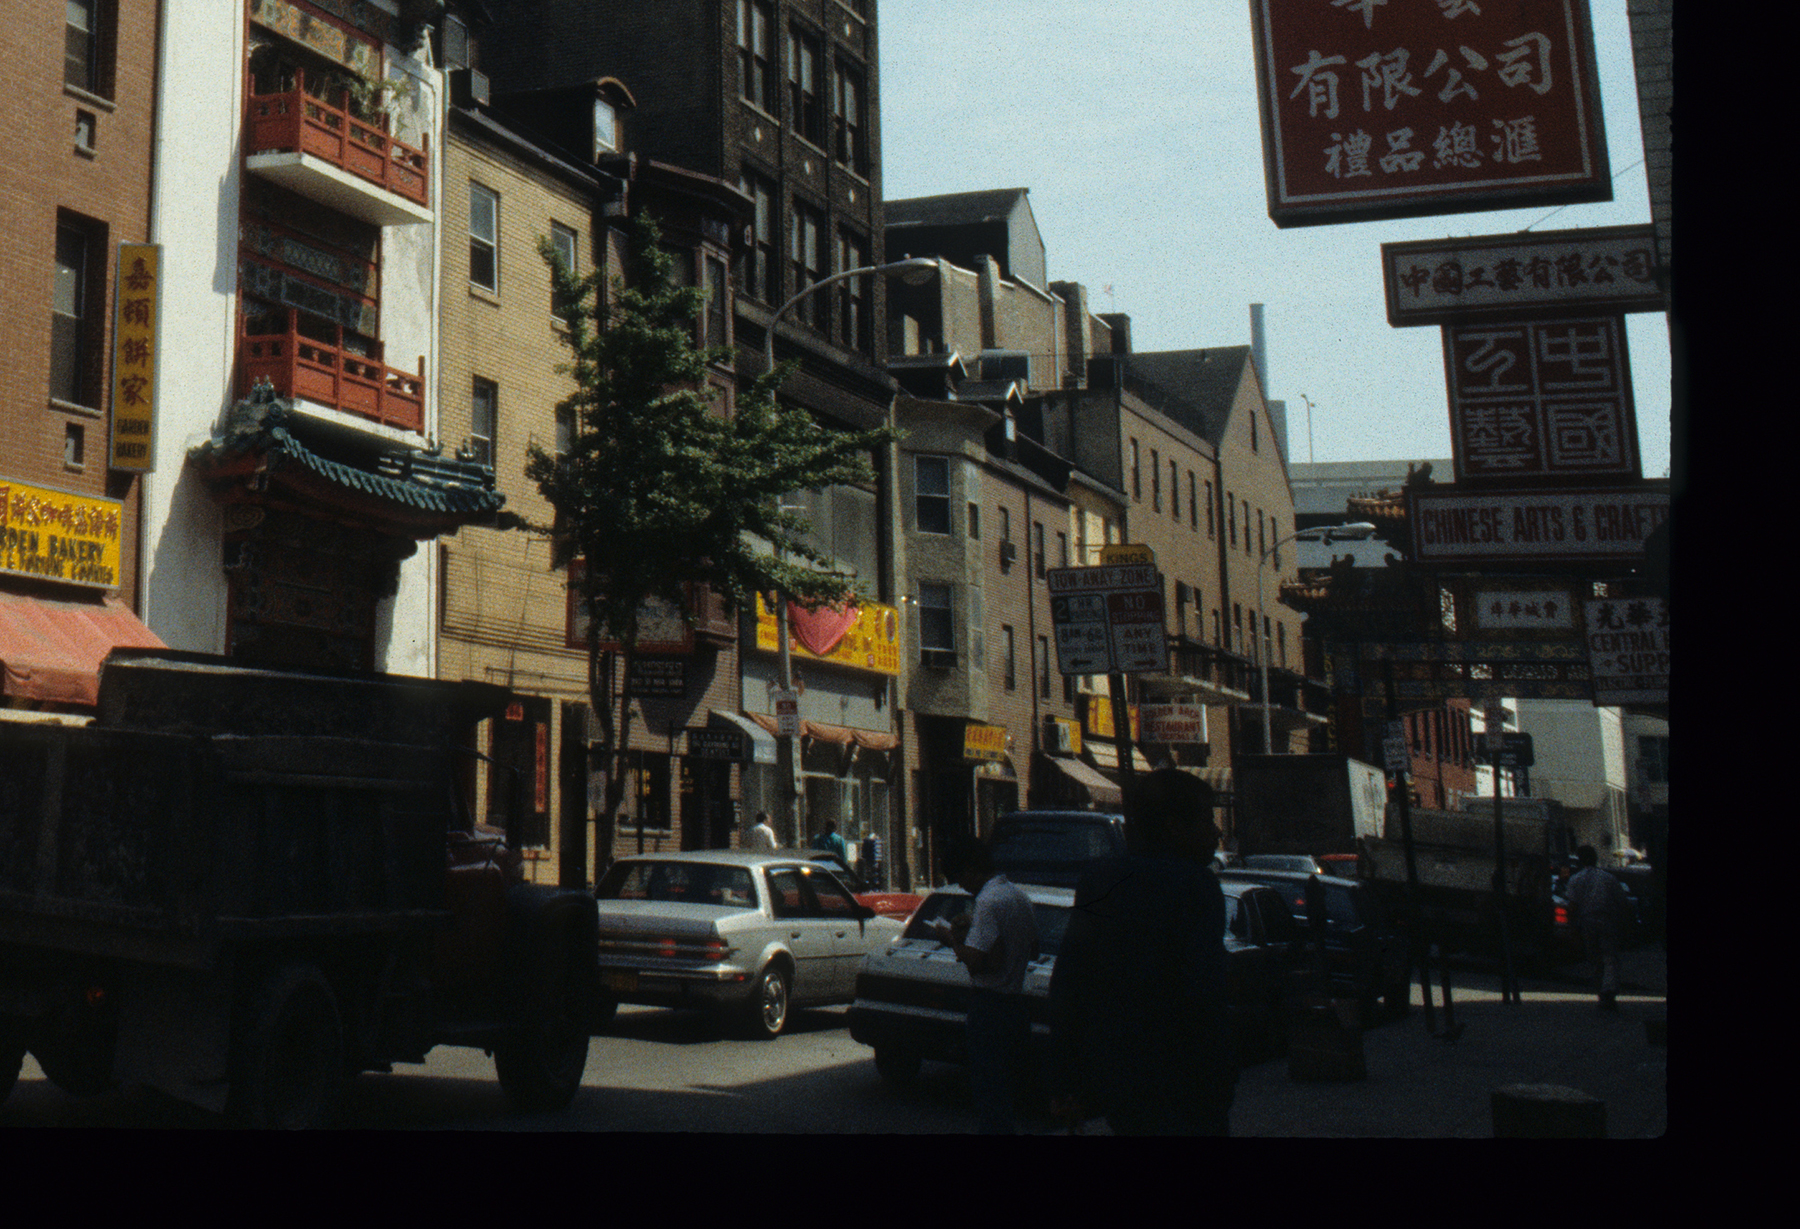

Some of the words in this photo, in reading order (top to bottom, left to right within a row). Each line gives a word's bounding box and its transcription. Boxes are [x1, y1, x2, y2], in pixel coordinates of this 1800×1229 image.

[1290, 32, 1552, 119] 有限公司
[1422, 507, 1505, 544] CHINESE
[1513, 506, 1565, 543] ARTS
[48, 534, 106, 561] BAKERY
[1121, 568, 1152, 584] ZONE
[1055, 600, 1067, 620] 2
[1124, 595, 1146, 610] NO
[1124, 628, 1152, 639] ANY
[1589, 631, 1659, 652] CENTRAL
[1123, 643, 1156, 654] TIME
